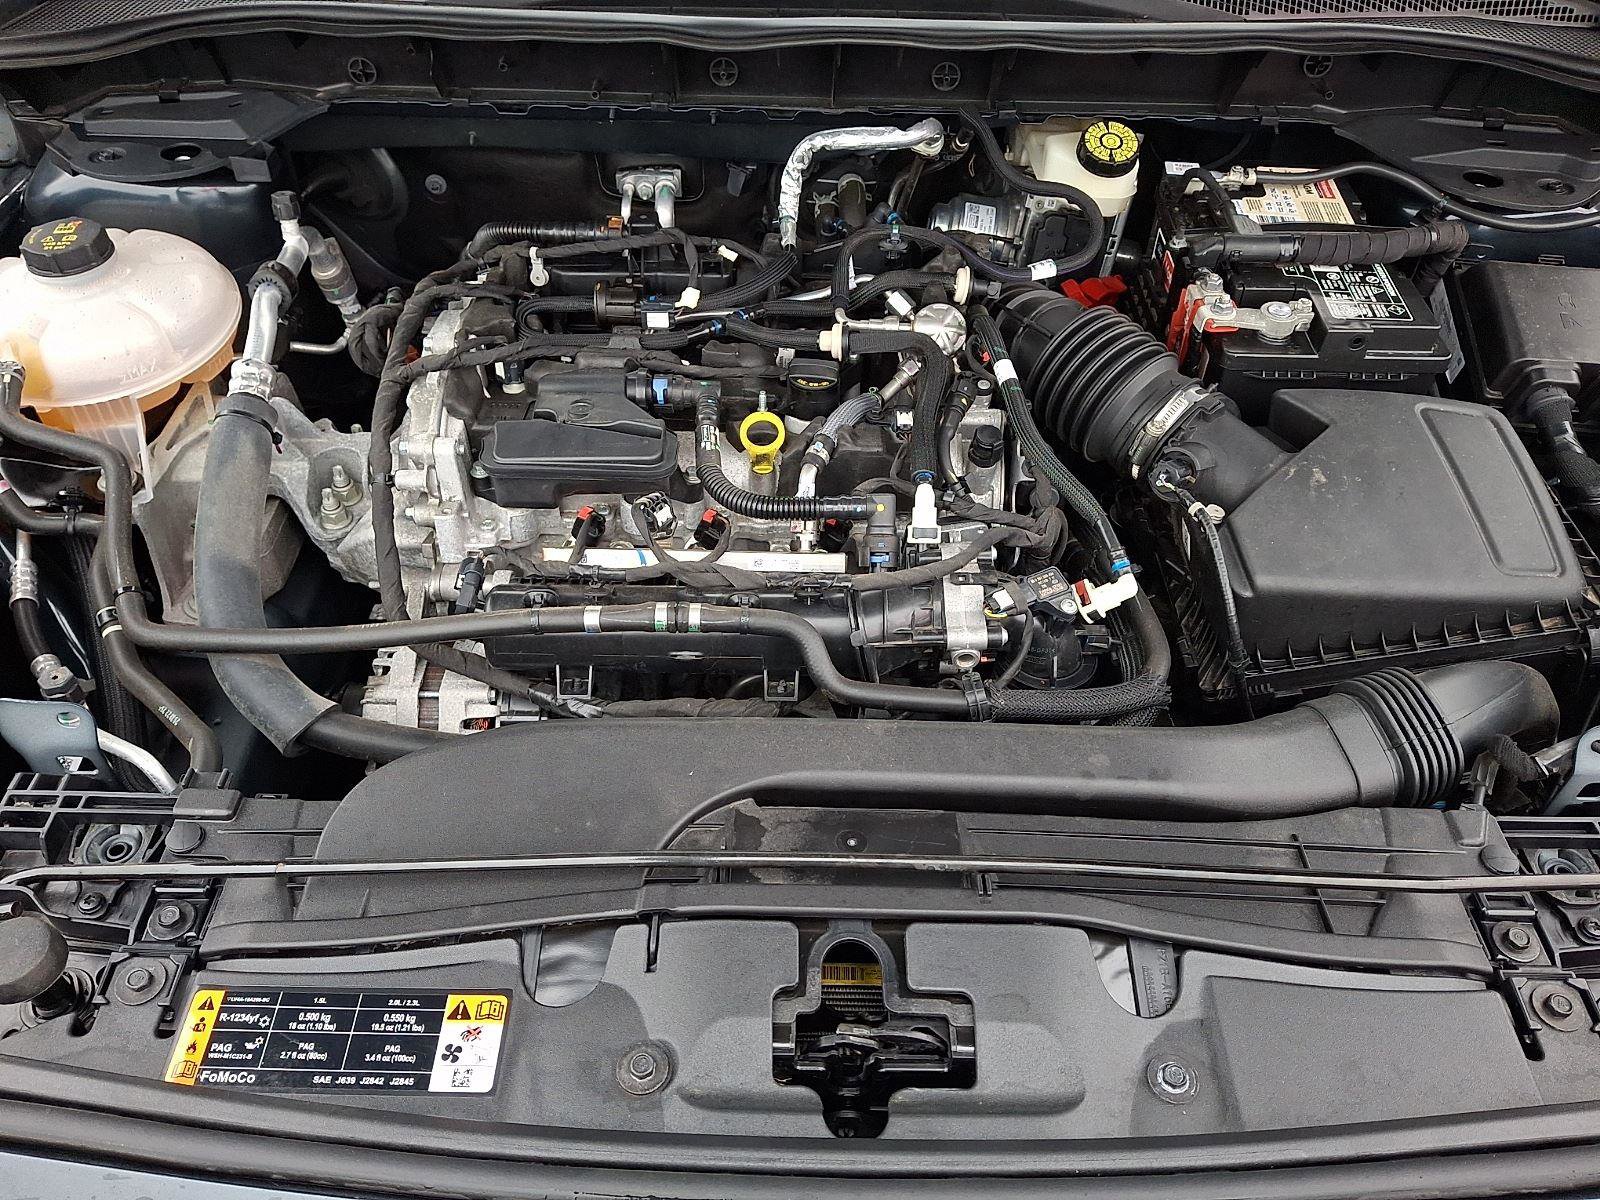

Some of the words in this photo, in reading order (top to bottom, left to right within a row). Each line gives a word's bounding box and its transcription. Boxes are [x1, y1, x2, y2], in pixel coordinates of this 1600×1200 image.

[218, 1012, 260, 1025] R-1234yf
[298, 1011, 320, 1021] 0.500
[320, 1012, 332, 1023] kg
[383, 1013, 404, 1022] 0.550
[405, 1013, 417, 1024] kg
[288, 1022, 297, 1030] 18
[306, 1022, 322, 1031] (1.10
[322, 1022, 337, 1031] lbs)
[371, 1023, 385, 1031] 19.5
[394, 1023, 411, 1032] (1.21
[411, 1024, 425, 1033] lbs)
[210, 1043, 232, 1052] PAG
[298, 1042, 315, 1051] PAG
[384, 1044, 400, 1053] PAG
[280, 1051, 291, 1059] 2.7
[291, 1051, 297, 1059] fl
[306, 1052, 328, 1061] (80cc)
[364, 1053, 376, 1062] 3.4
[375, 1054, 382, 1062] fl
[391, 1054, 416, 1064] (100cc)
[199, 1070, 256, 1084] FoMoCo
[312, 1075, 332, 1084] SAE
[335, 1076, 356, 1084] J639
[359, 1077, 384, 1085] J2842
[389, 1077, 414, 1086] J2845
